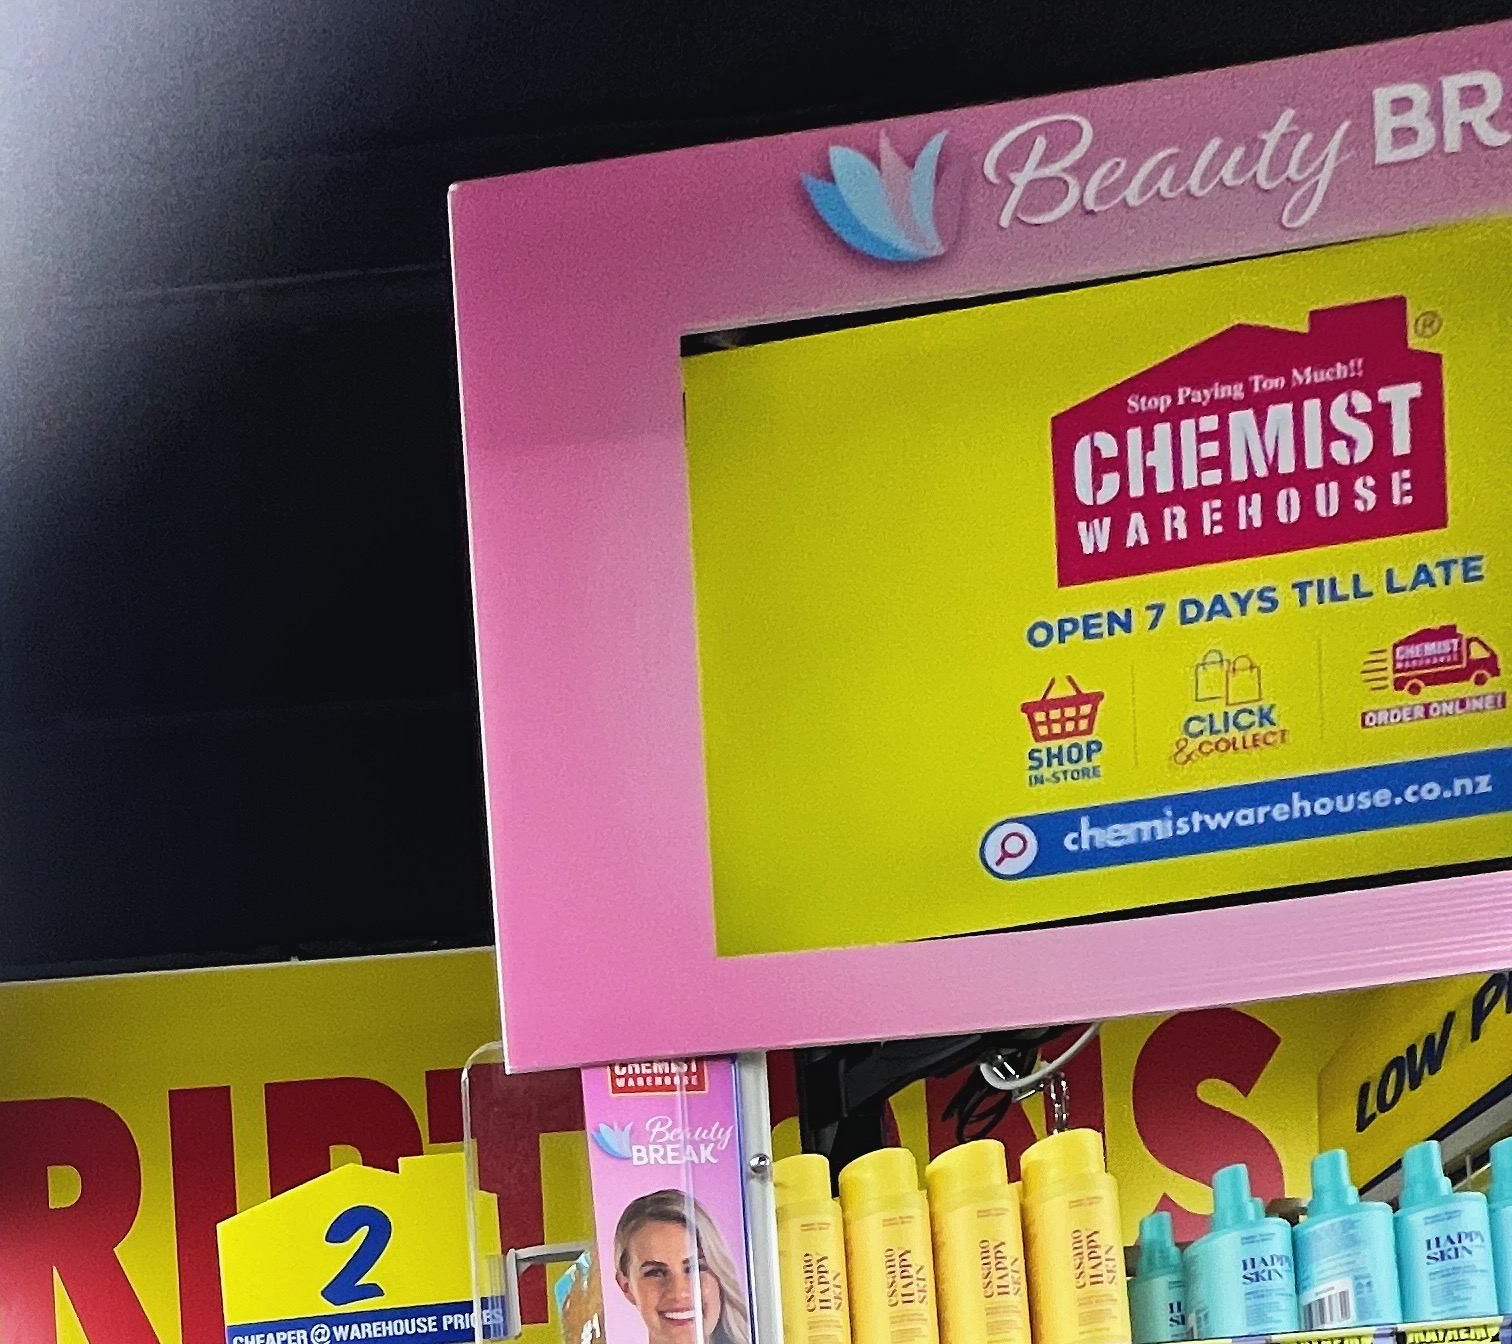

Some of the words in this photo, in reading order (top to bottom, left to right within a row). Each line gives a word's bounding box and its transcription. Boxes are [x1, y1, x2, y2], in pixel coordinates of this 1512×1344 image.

[984, 107, 1352, 229] Beauty
[1127, 391, 1172, 414] Stop
[1178, 380, 1245, 410] Paying
[1249, 373, 1286, 392] Too
[1291, 357, 1364, 388] Much!!
[1072, 382, 1422, 507] CHEMIST
[1078, 468, 1414, 556] WAREHOUSE
[1026, 607, 1133, 649] OPEN
[1146, 602, 1166, 632] 7
[1179, 586, 1279, 626] DAYS
[1291, 573, 1373, 607] TILL
[1386, 555, 1485, 594] LATE
[1183, 703, 1277, 740] CLICK
[1363, 705, 1426, 728] ORDER
[1429, 692, 1505, 717] ONLINE!
[1028, 739, 1103, 770] SHOP
[1029, 765, 1101, 788] IN-STORE
[1063, 773, 1492, 853] chemistwarehouse.co.nz
[1354, 1012, 1457, 1135] LOW
[631, 1142, 718, 1166] BREAK
[321, 1205, 392, 1306] 2
[1425, 1230, 1485, 1252] HAPPY
[1426, 1247, 1473, 1265] SKIN
[333, 1316, 438, 1342] WAREHOUSE
